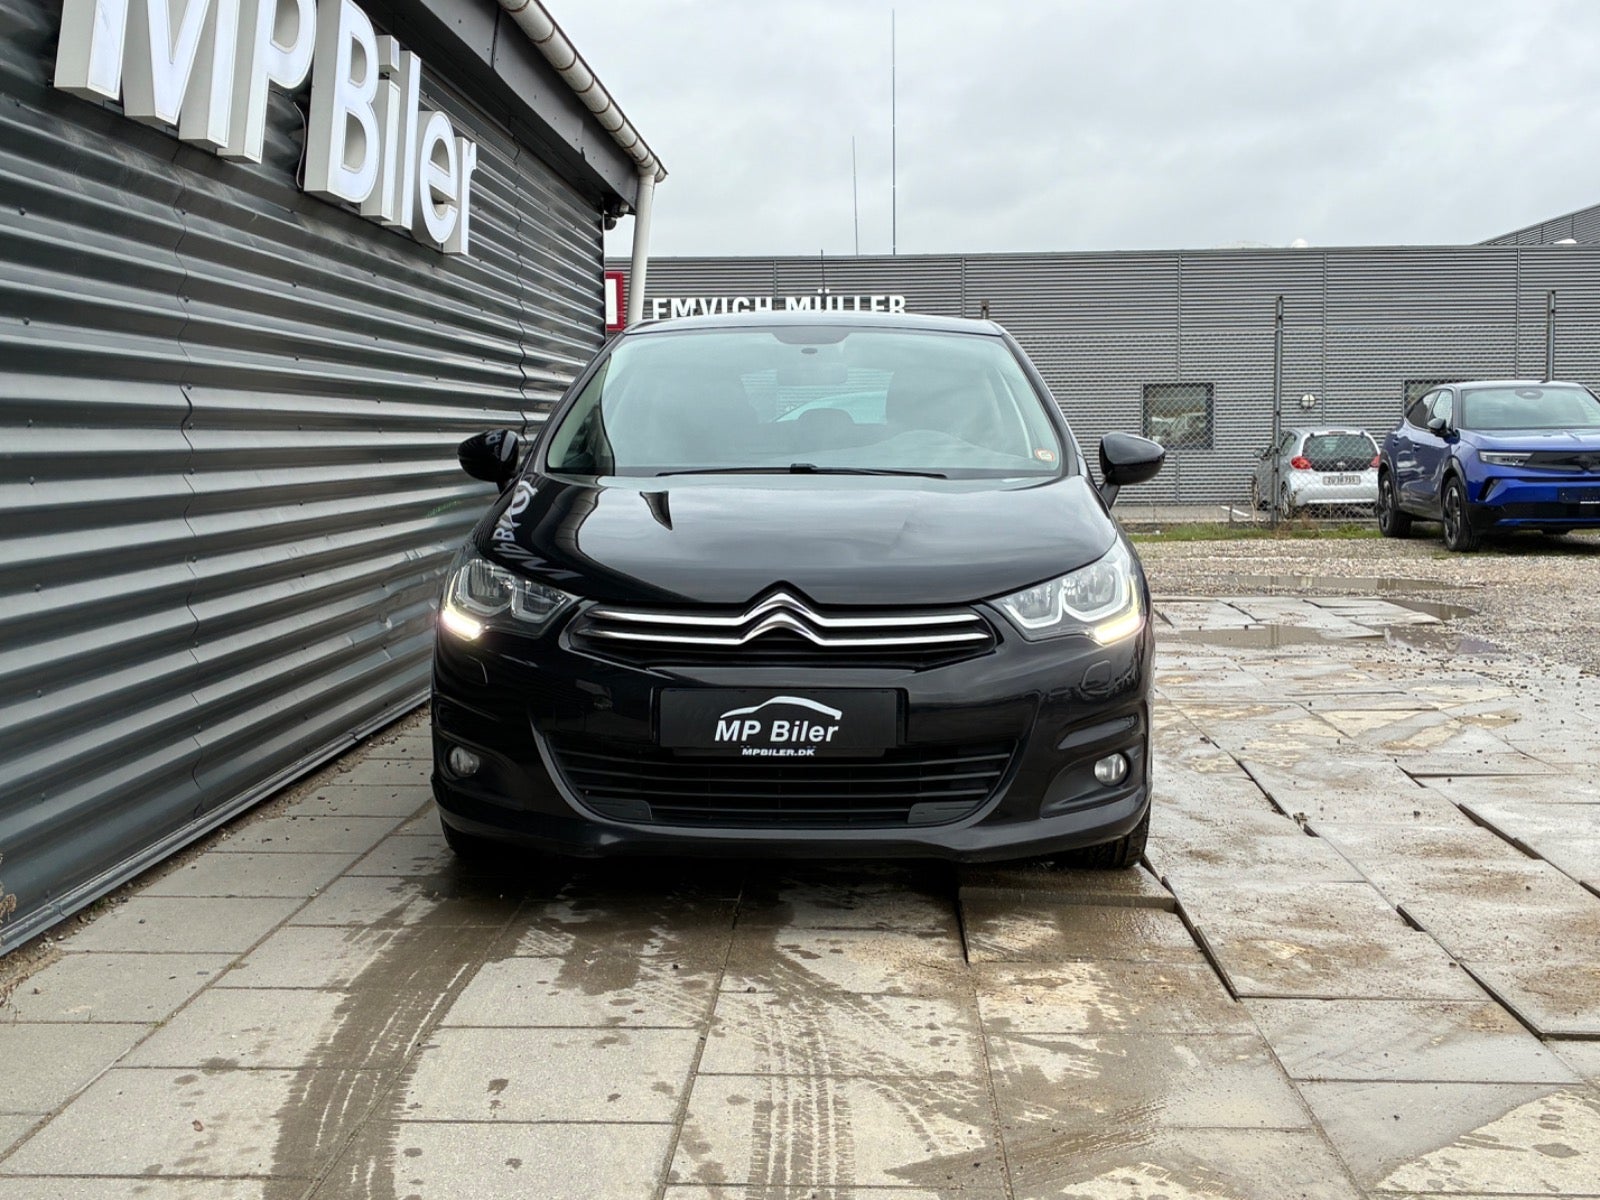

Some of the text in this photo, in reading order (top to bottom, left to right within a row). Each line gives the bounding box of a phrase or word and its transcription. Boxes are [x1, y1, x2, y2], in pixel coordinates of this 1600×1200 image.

[322, 0, 477, 256] Biler
[714, 720, 839, 742] MP Biler
[741, 748, 816, 757] MPBILER.DK
